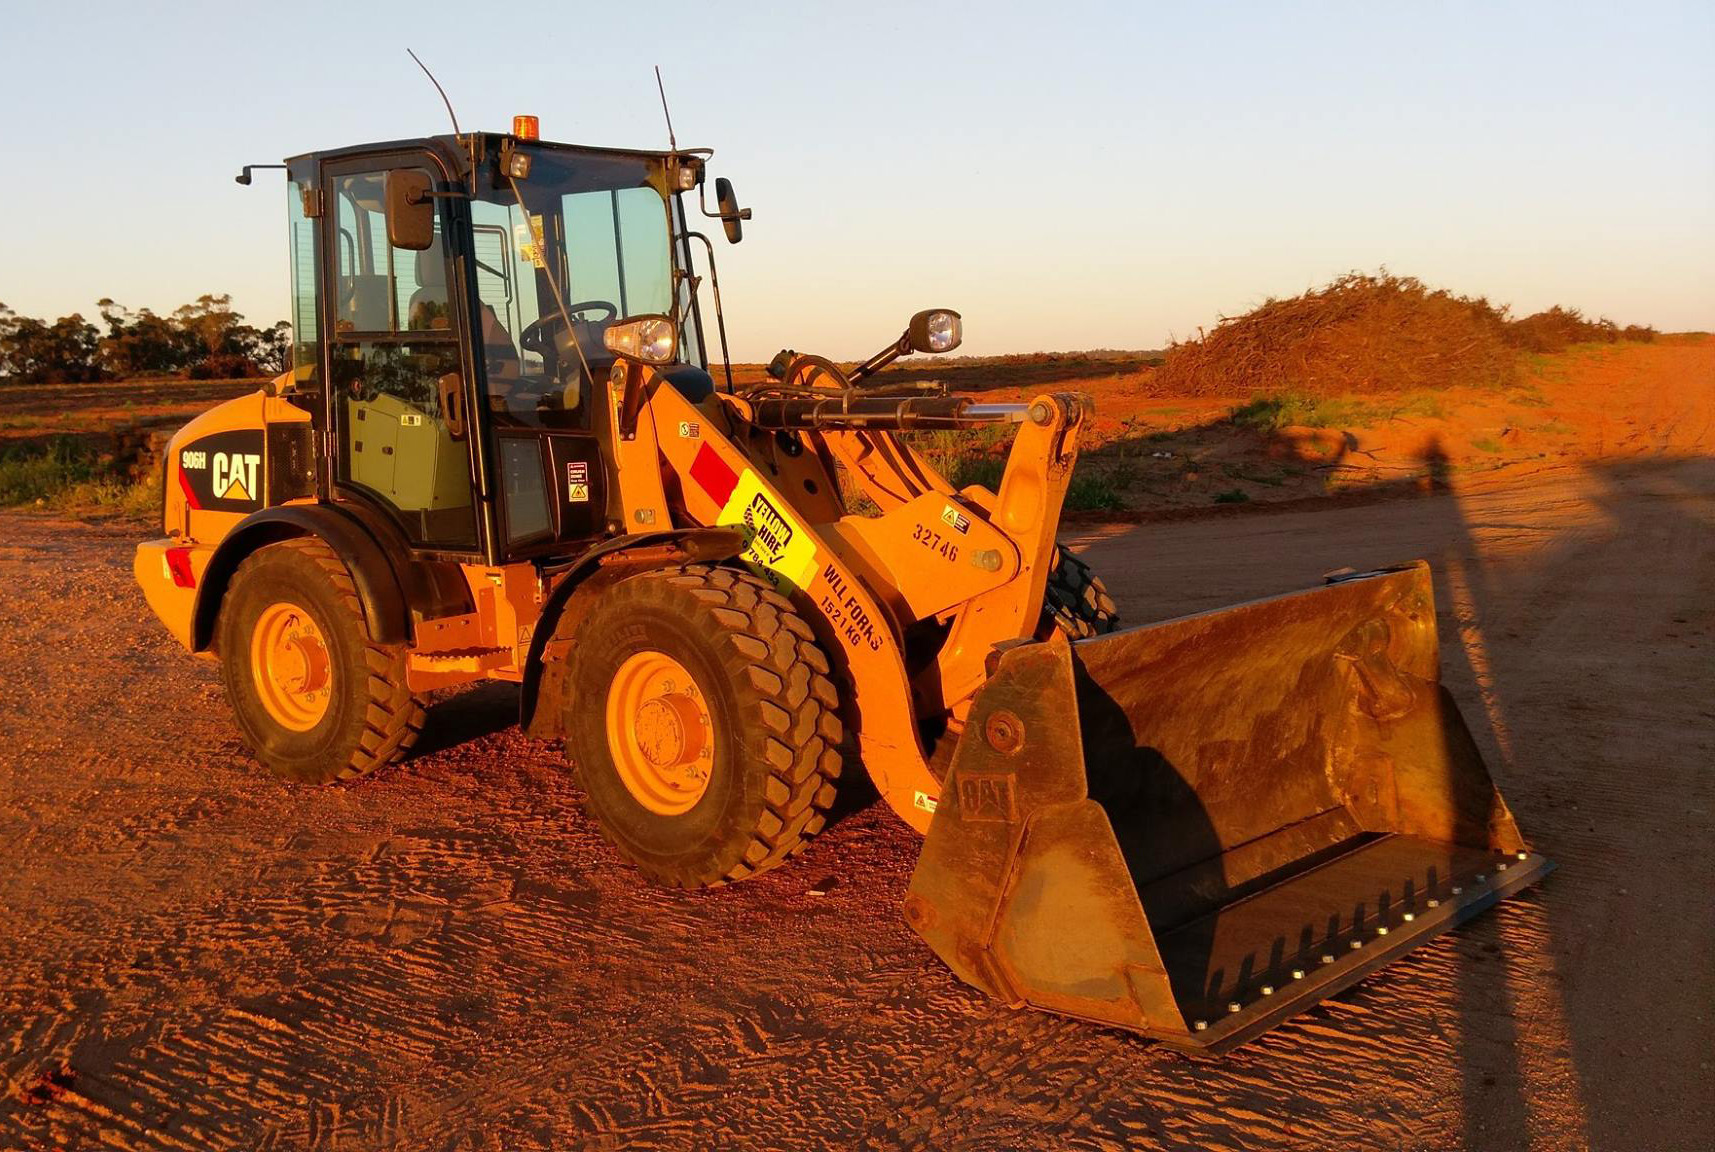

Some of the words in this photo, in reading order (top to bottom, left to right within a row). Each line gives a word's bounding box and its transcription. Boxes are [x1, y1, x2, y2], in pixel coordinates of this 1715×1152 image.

[182, 450, 206, 469] 906H
[212, 451, 261, 501] CAT
[754, 495, 791, 546] YELLOW
[758, 524, 782, 555] HIRE
[912, 523, 959, 562] 32746
[821, 596, 847, 628] 1521
[845, 624, 861, 647] KG
[823, 563, 848, 602] WLL
[844, 596, 884, 651] FORKS
